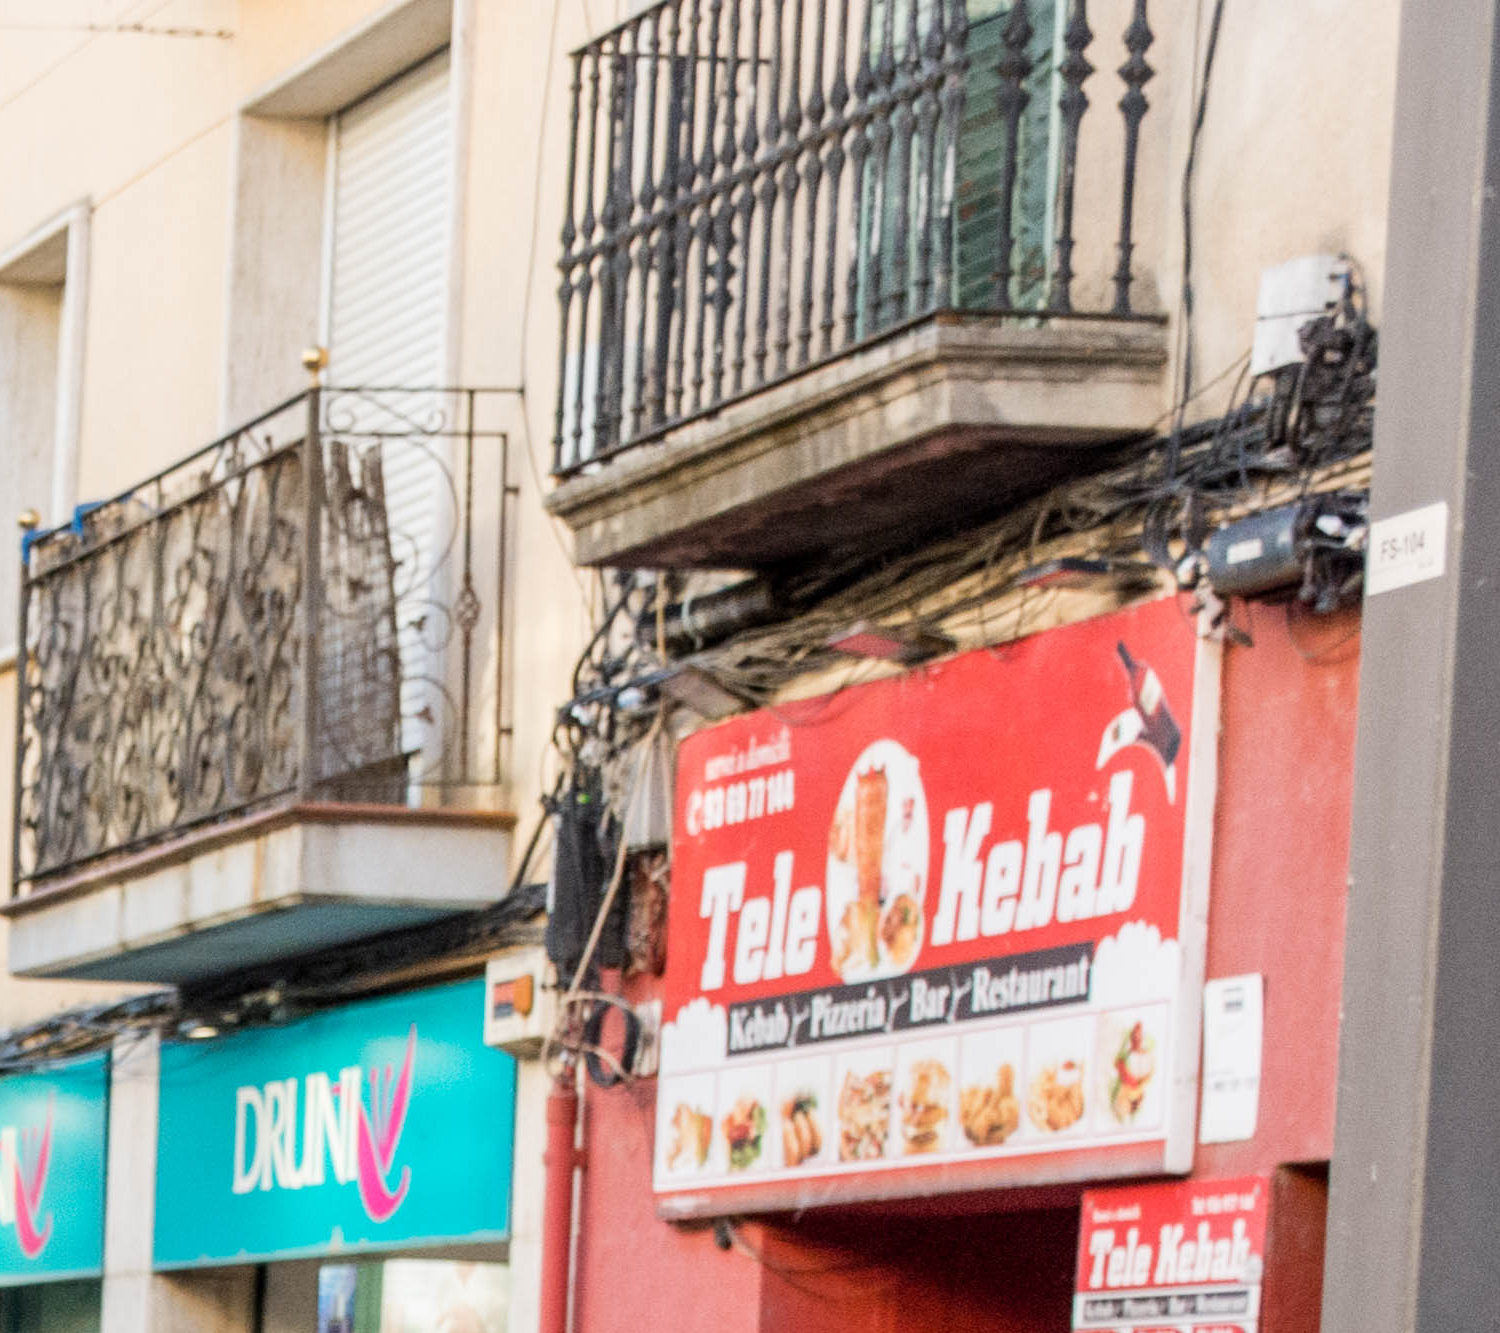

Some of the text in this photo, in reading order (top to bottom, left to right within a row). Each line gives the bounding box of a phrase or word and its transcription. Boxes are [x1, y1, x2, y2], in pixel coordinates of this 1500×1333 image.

[700, 769, 1146, 991] Tele Kebab
[729, 956, 1090, 1051] Kebab Pizzeria Bar Restaurant
[1089, 1218, 1252, 1288] Tele Kebab
